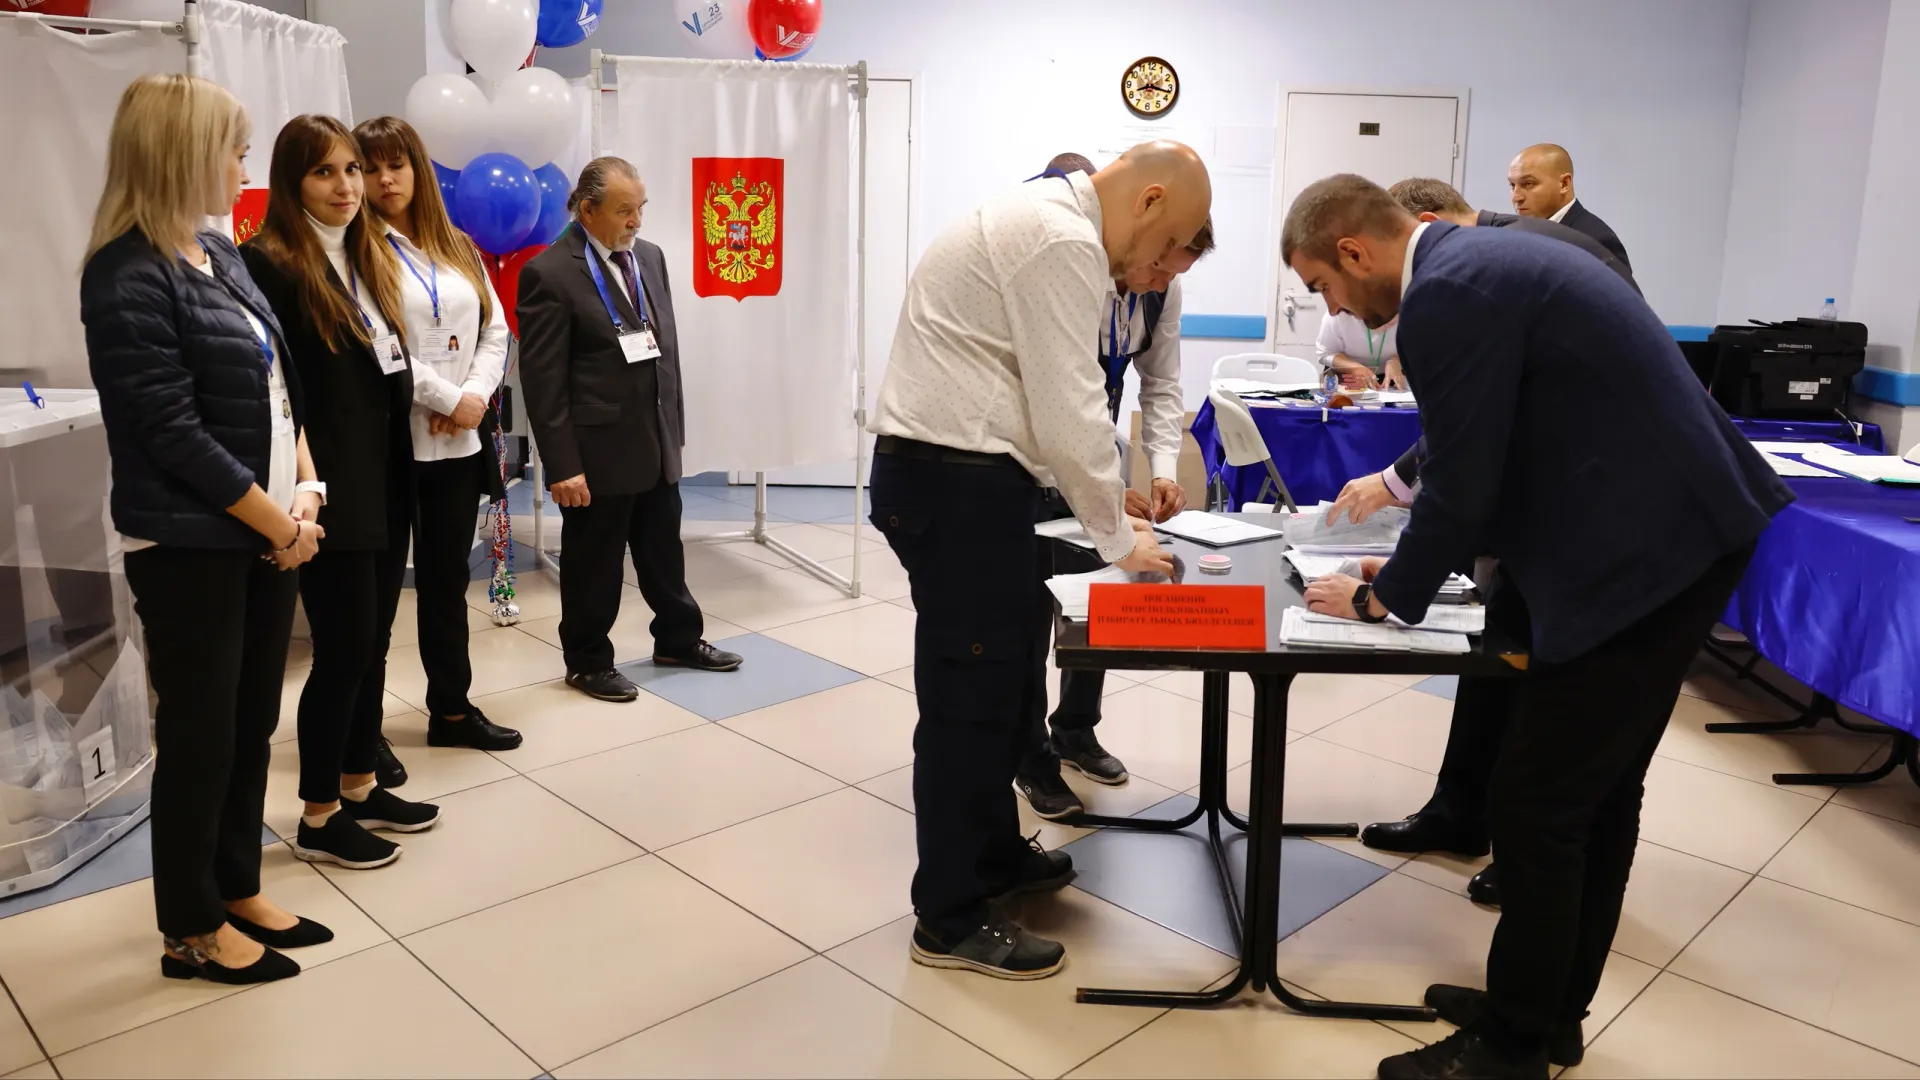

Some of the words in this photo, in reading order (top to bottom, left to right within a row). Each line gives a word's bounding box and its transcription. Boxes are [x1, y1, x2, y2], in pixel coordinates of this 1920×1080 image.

[708, 3, 720, 17] 23
[1148, 62, 1156, 70] 12
[1165, 74, 1171, 82] 2
[1129, 90, 1134, 99] 8
[1143, 594, 1206, 603] ПОГАШЕНИЕ
[1096, 615, 1184, 625] ИЗБИРАТЕЛЬНЫХ
[1185, 617, 1255, 626] БЮЛЛЕТЕНЕЙ
[91, 746, 106, 780] 1
